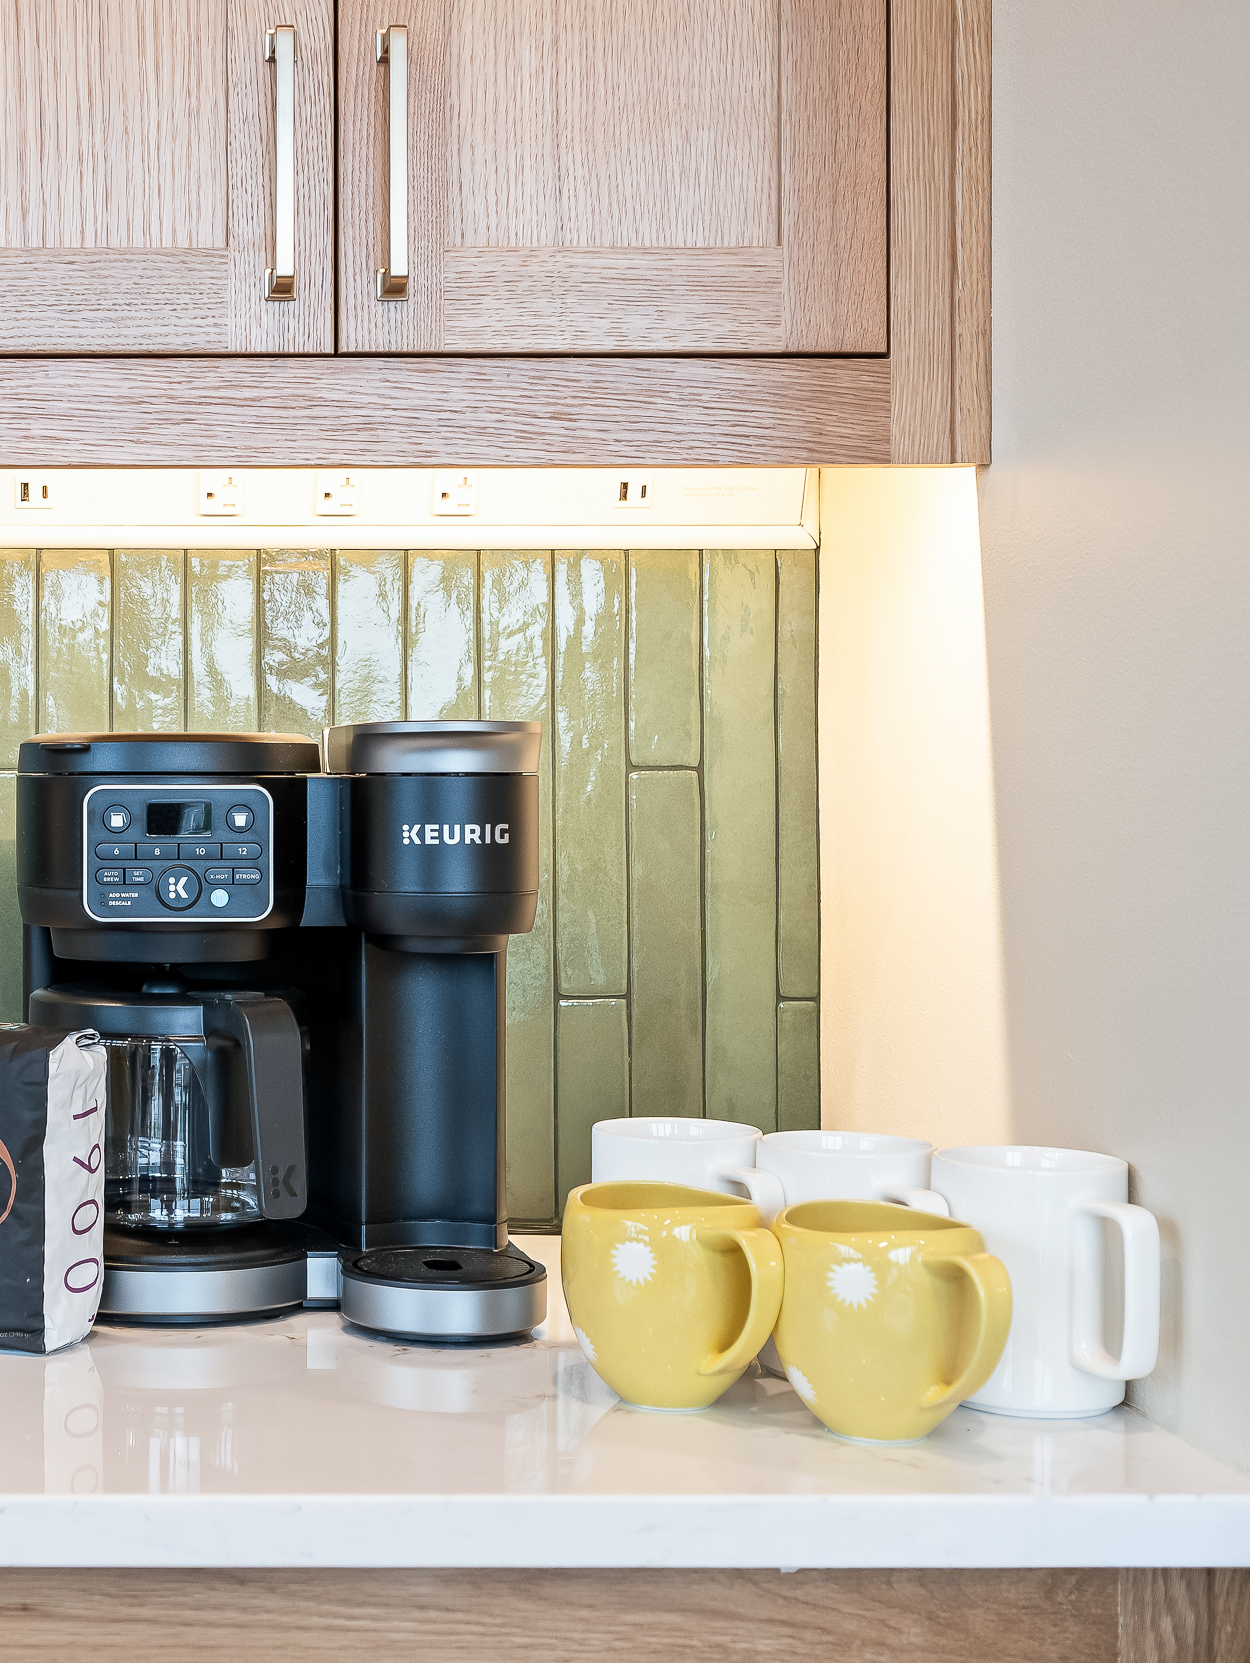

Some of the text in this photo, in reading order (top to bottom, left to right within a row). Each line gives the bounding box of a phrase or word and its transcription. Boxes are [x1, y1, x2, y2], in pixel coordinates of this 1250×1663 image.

[402, 823, 510, 845] KEURIG
[113, 847, 120, 855] 6
[154, 847, 161, 856] 8
[195, 847, 206, 856] 10
[237, 847, 248, 855] 12
[63, 1099, 102, 1293] 1900
